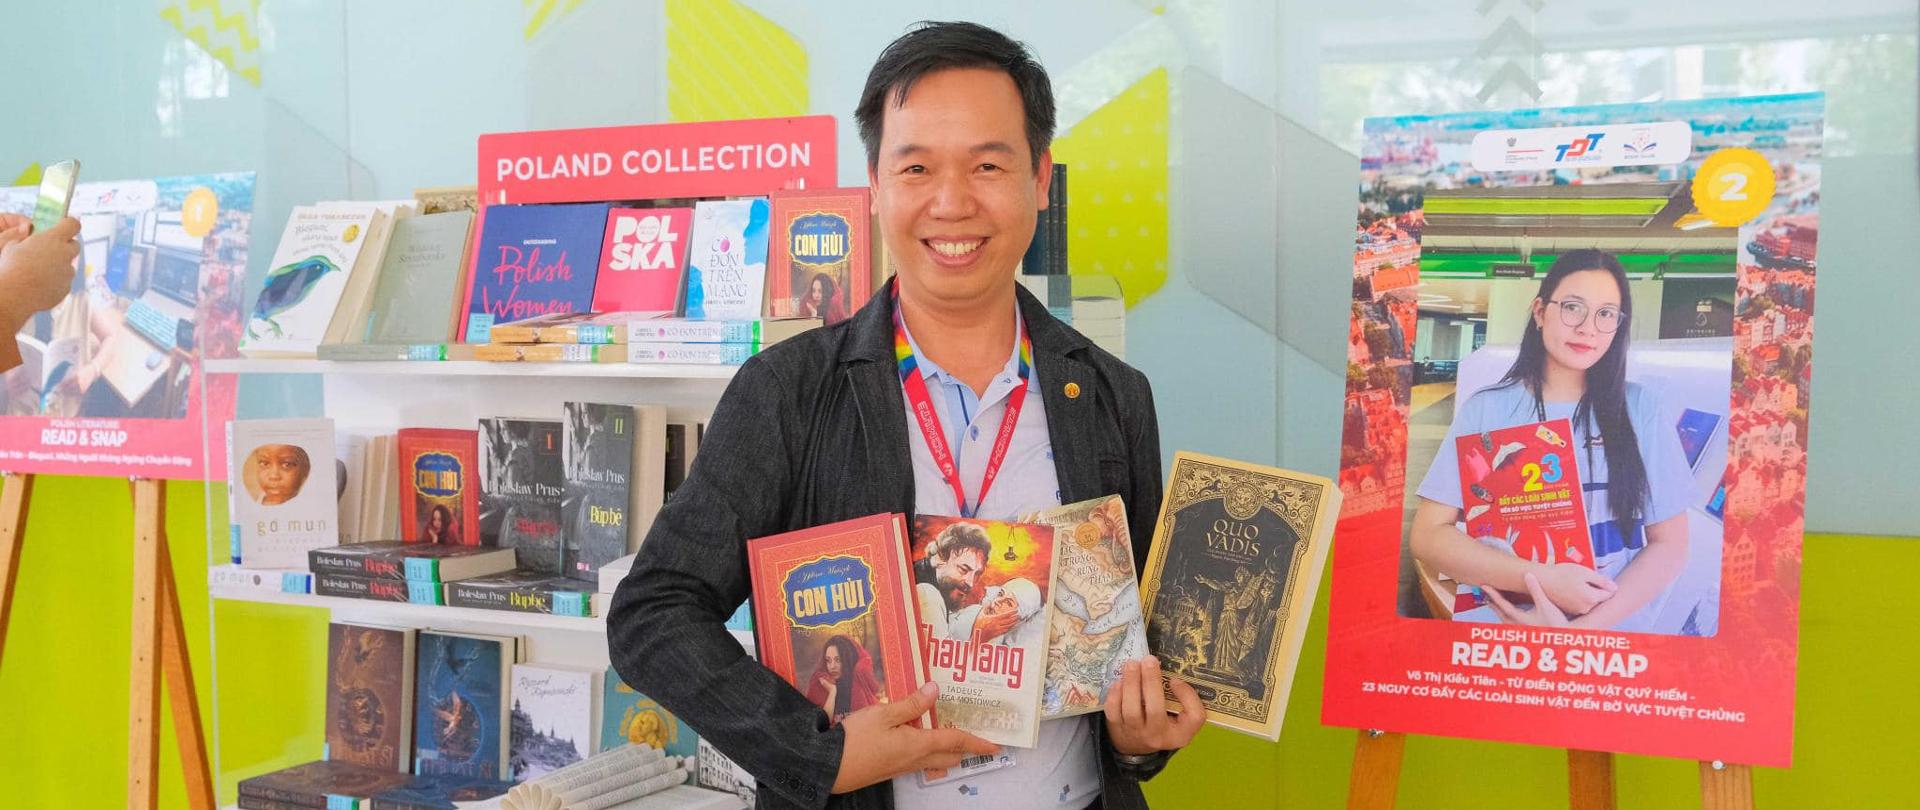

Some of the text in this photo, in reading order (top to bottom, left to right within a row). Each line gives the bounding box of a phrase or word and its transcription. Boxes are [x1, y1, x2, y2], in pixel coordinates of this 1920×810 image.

[497, 142, 811, 182] POLAND COLLECTION
[1719, 173, 1748, 201] 2
[613, 214, 679, 243] POL
[609, 241, 676, 271] SKA
[794, 234, 819, 257] CON
[493, 244, 573, 287] Polish
[483, 283, 573, 318] Women
[41, 428, 128, 447] READ & SNAP
[605, 468, 625, 484] Prus
[1520, 453, 1563, 492] 23
[536, 482, 560, 496] Prus
[288, 518, 327, 532] mun
[1213, 518, 1260, 540] QUO
[1206, 532, 1261, 557] VADIS
[793, 577, 866, 618] CON HỦI
[1471, 627, 1631, 649] POLISH LITERATURE:
[971, 629, 1024, 689] lang
[1451, 641, 1649, 679] READ & SNAP
[947, 686, 984, 697] TADEUSZ
[1425, 671, 1441, 684] Thị
[1507, 675, 1523, 689] TỪ
[1557, 680, 1595, 695] ĐỘNG
[1597, 683, 1623, 697] VẬT
[1654, 688, 1688, 702] HIẾM
[1362, 682, 1376, 692] 23
[1377, 683, 1410, 695] NGUY
[1412, 686, 1430, 697] CƠ
[1458, 688, 1482, 701] CÁC
[1484, 690, 1513, 703] LOÀI
[1515, 695, 1545, 706] SINH
[1547, 696, 1571, 710] VẬT
[1573, 697, 1600, 711] ĐẾN
[1603, 700, 1622, 713] BỜ
[1625, 703, 1651, 716] VỰC
[1653, 705, 1695, 720] TUYỆT
[1696, 707, 1746, 723] CHỦNG
